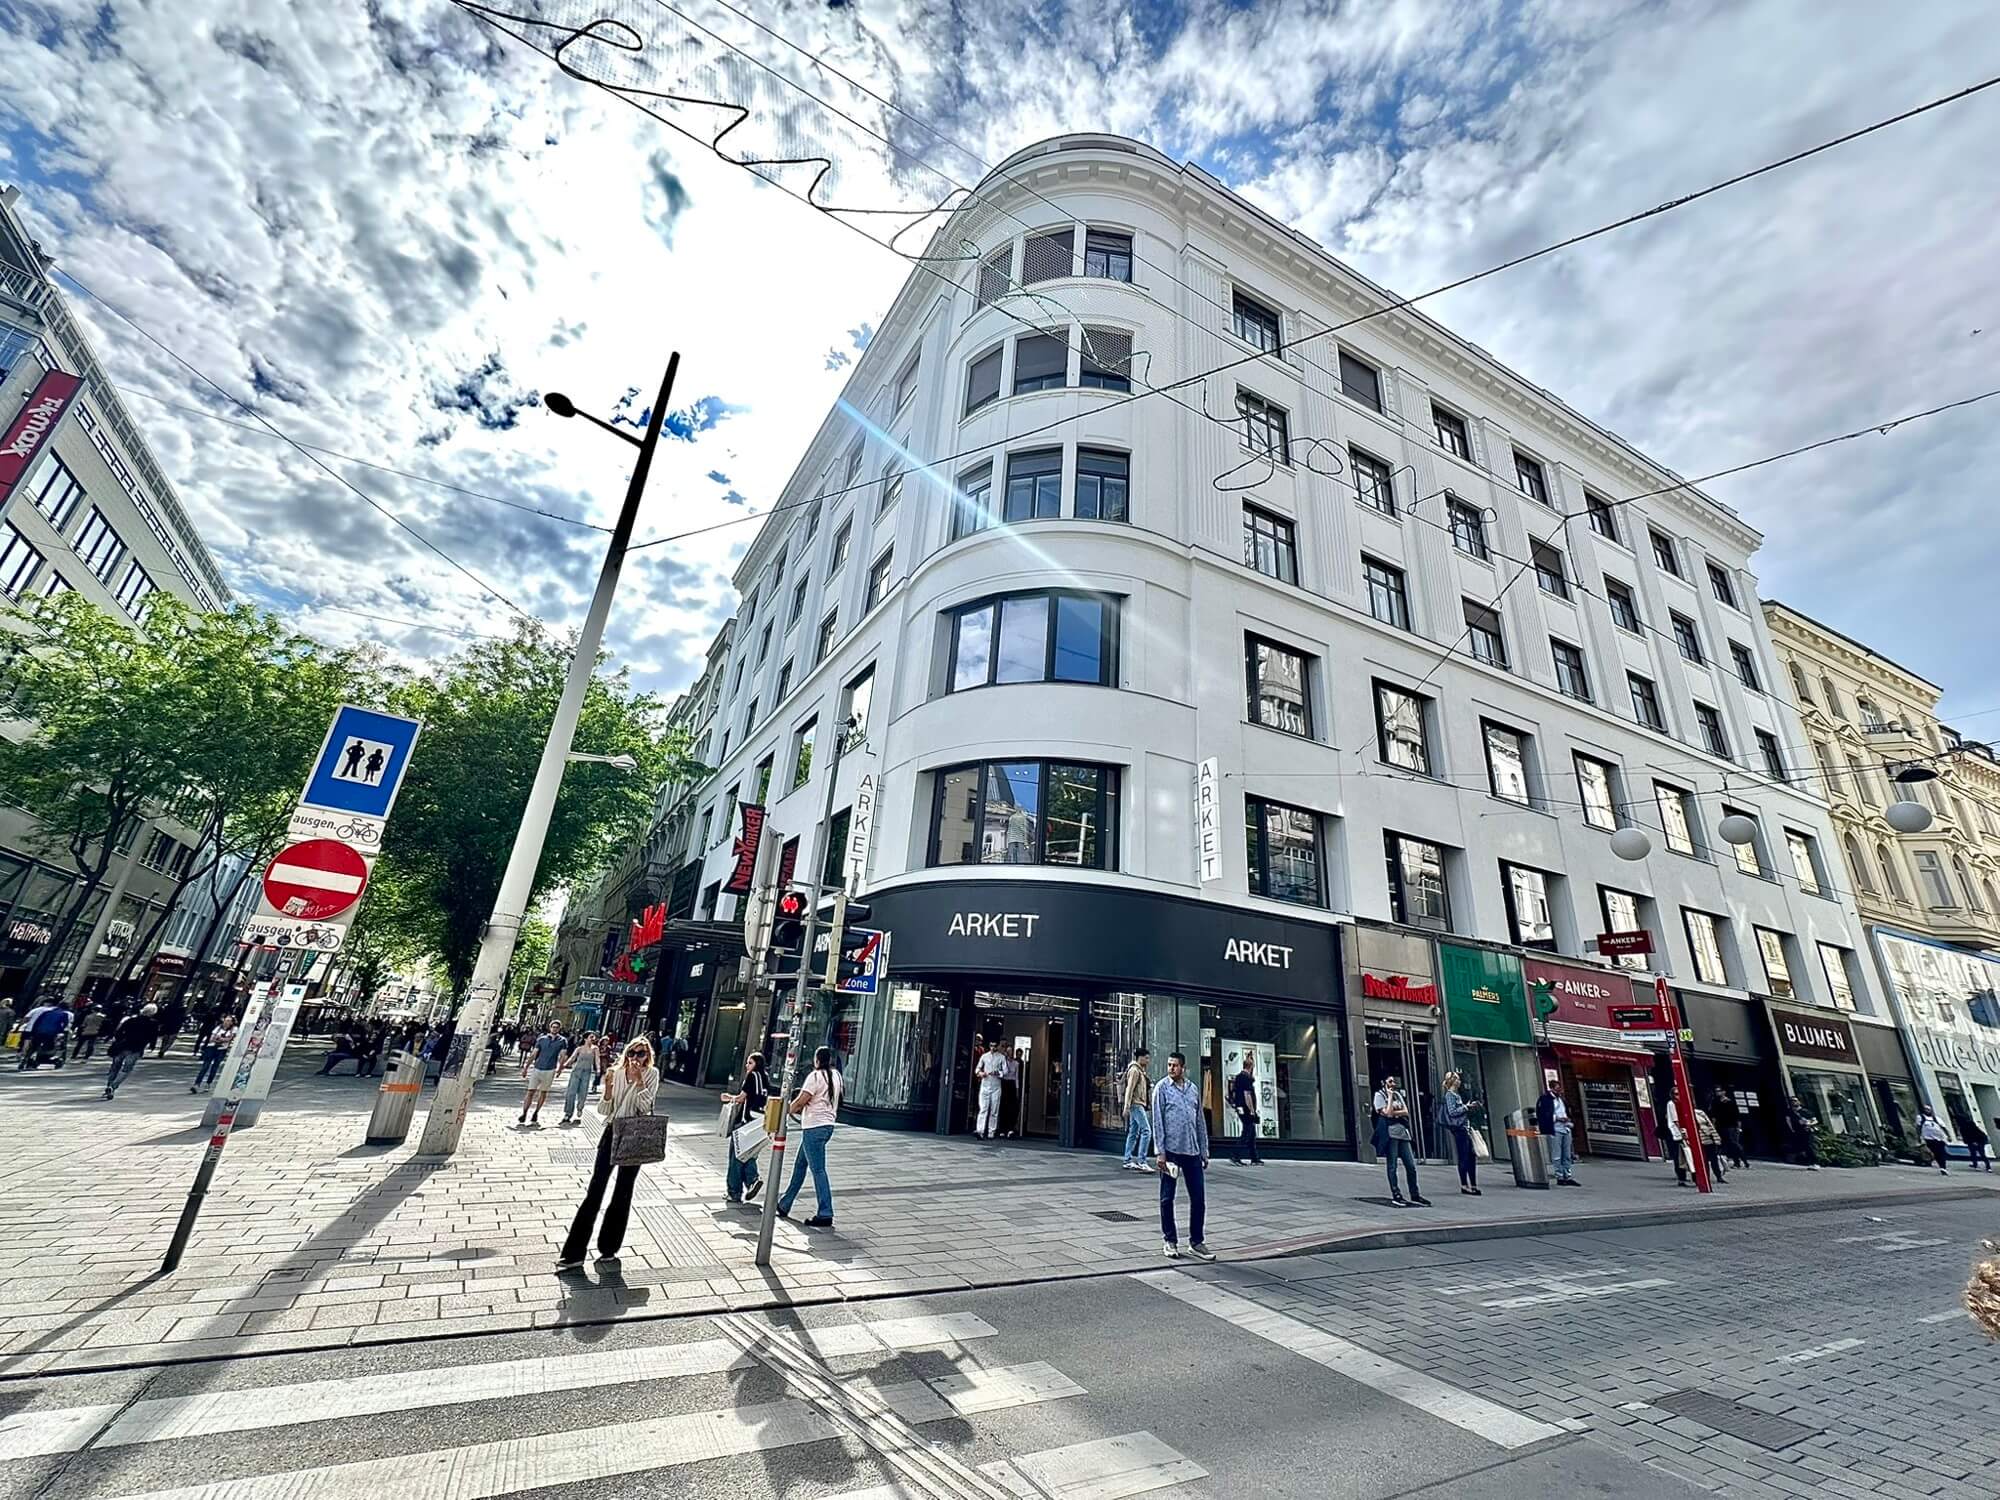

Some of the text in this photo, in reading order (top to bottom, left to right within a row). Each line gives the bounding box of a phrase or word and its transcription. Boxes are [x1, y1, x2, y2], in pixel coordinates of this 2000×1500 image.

[293, 813, 337, 831] ausgen.
[850, 774, 873, 874] ARKET
[1200, 763, 1215, 876] ARKET
[247, 922, 295, 938] ausgen.
[948, 912, 1039, 938] ARKET
[1610, 936, 1636, 945] ANKER
[1224, 938, 1293, 969] ARKET
[579, 981, 649, 994] APOTHEKE
[845, 978, 869, 989] Zone
[1565, 980, 1601, 998] ANKER
[1785, 1022, 1846, 1050] BLUMEN
